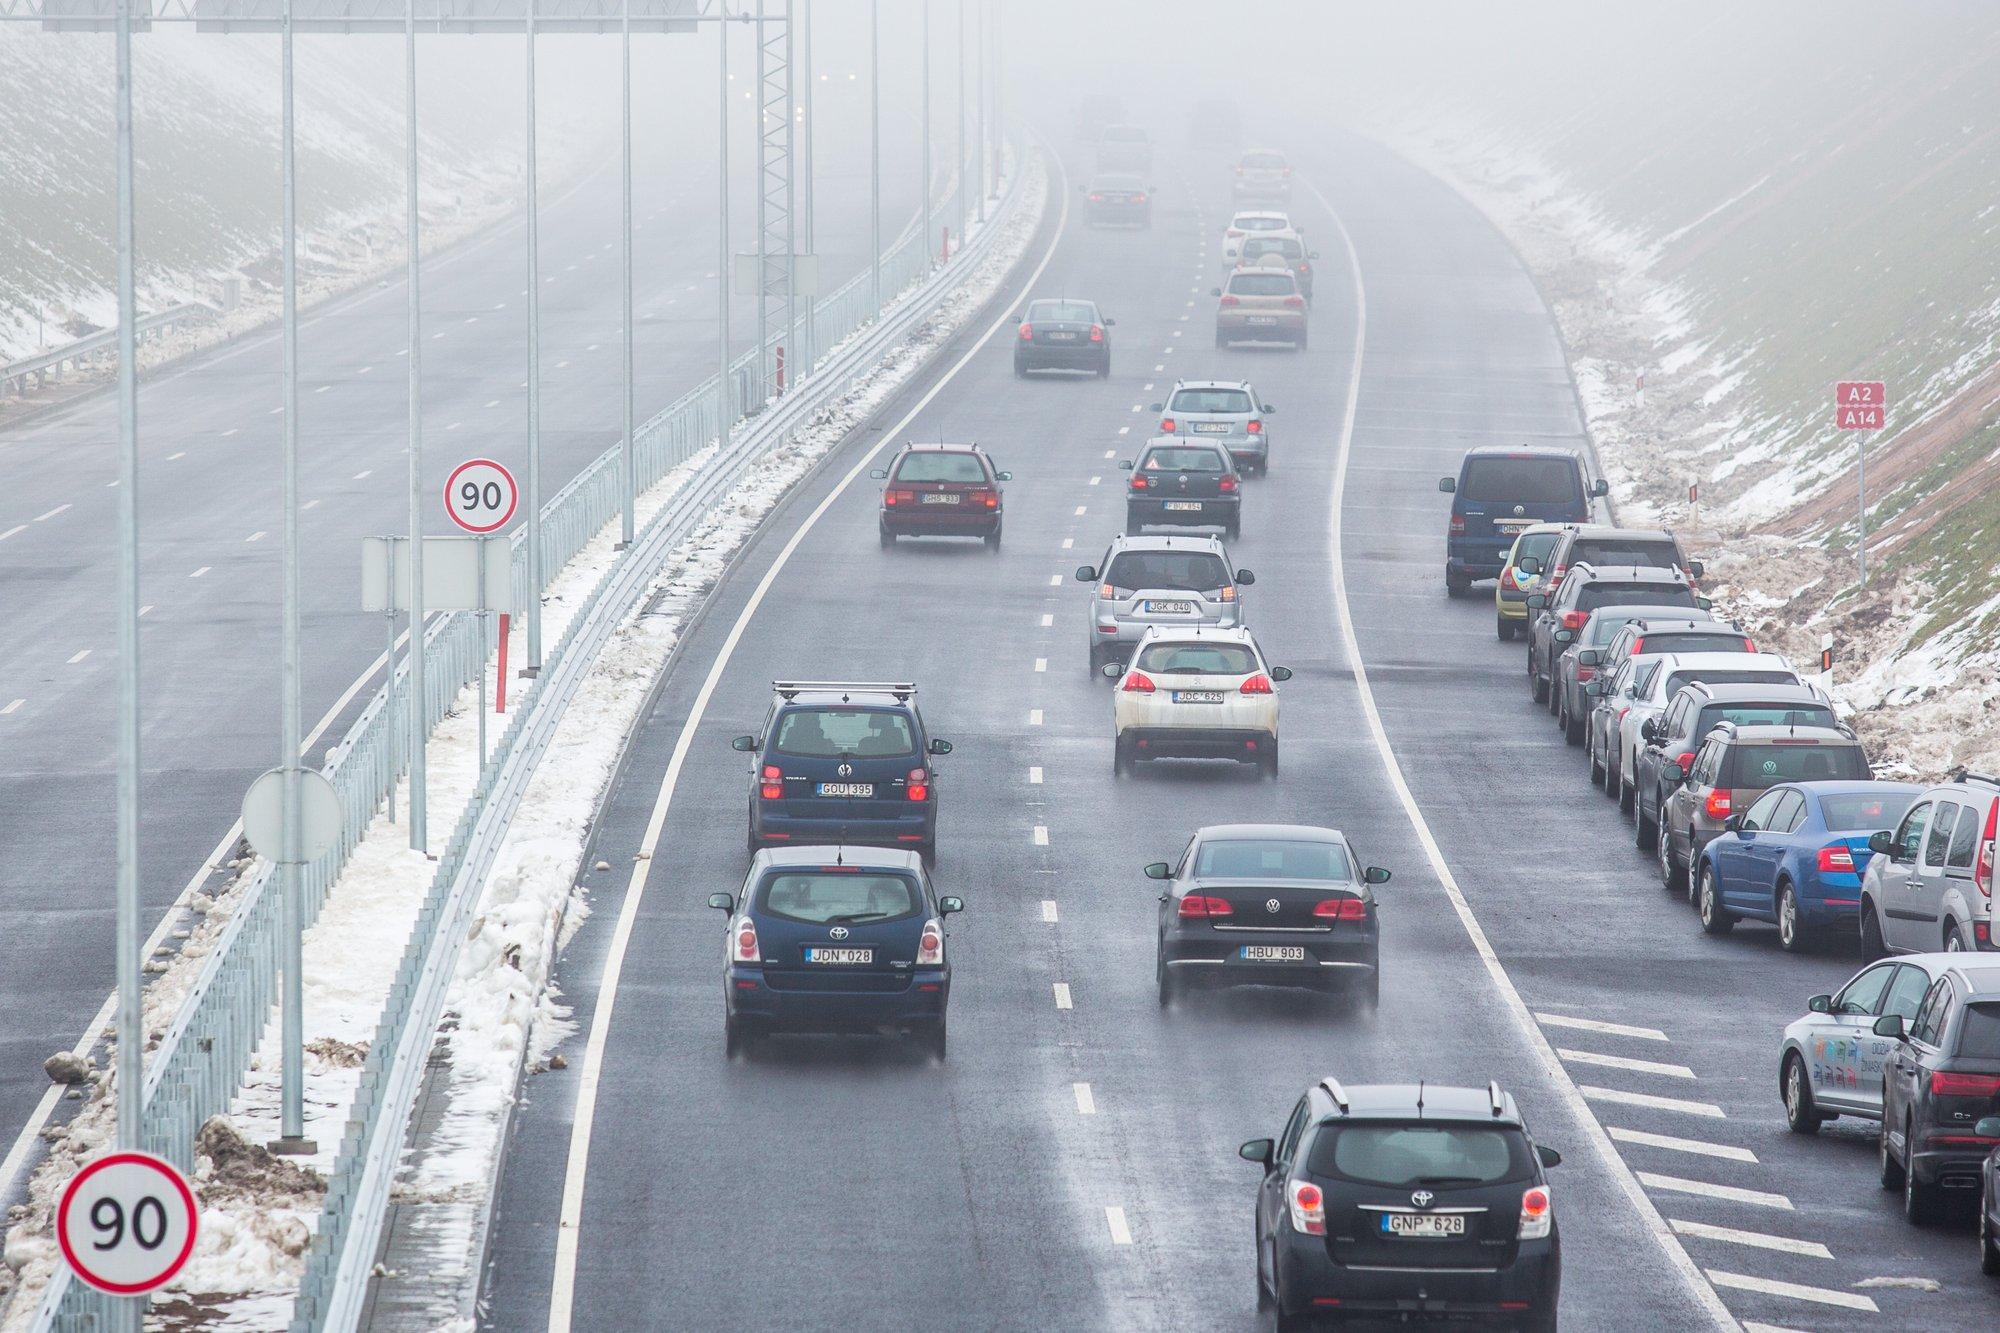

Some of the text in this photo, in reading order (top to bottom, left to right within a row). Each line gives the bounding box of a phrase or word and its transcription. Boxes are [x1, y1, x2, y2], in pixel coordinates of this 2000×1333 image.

[1849, 387, 1872, 401] A2
[1845, 411, 1876, 425] A14
[461, 482, 502, 511] 90
[1151, 601, 1189, 612] JGK 040
[1179, 691, 1222, 701] JDC 625
[823, 783, 871, 795] GOU 395
[813, 950, 870, 962] JDN 028
[1247, 947, 1303, 959] HBU 903
[90, 1196, 168, 1251] 90
[1391, 1216, 1462, 1232] GNP 628
